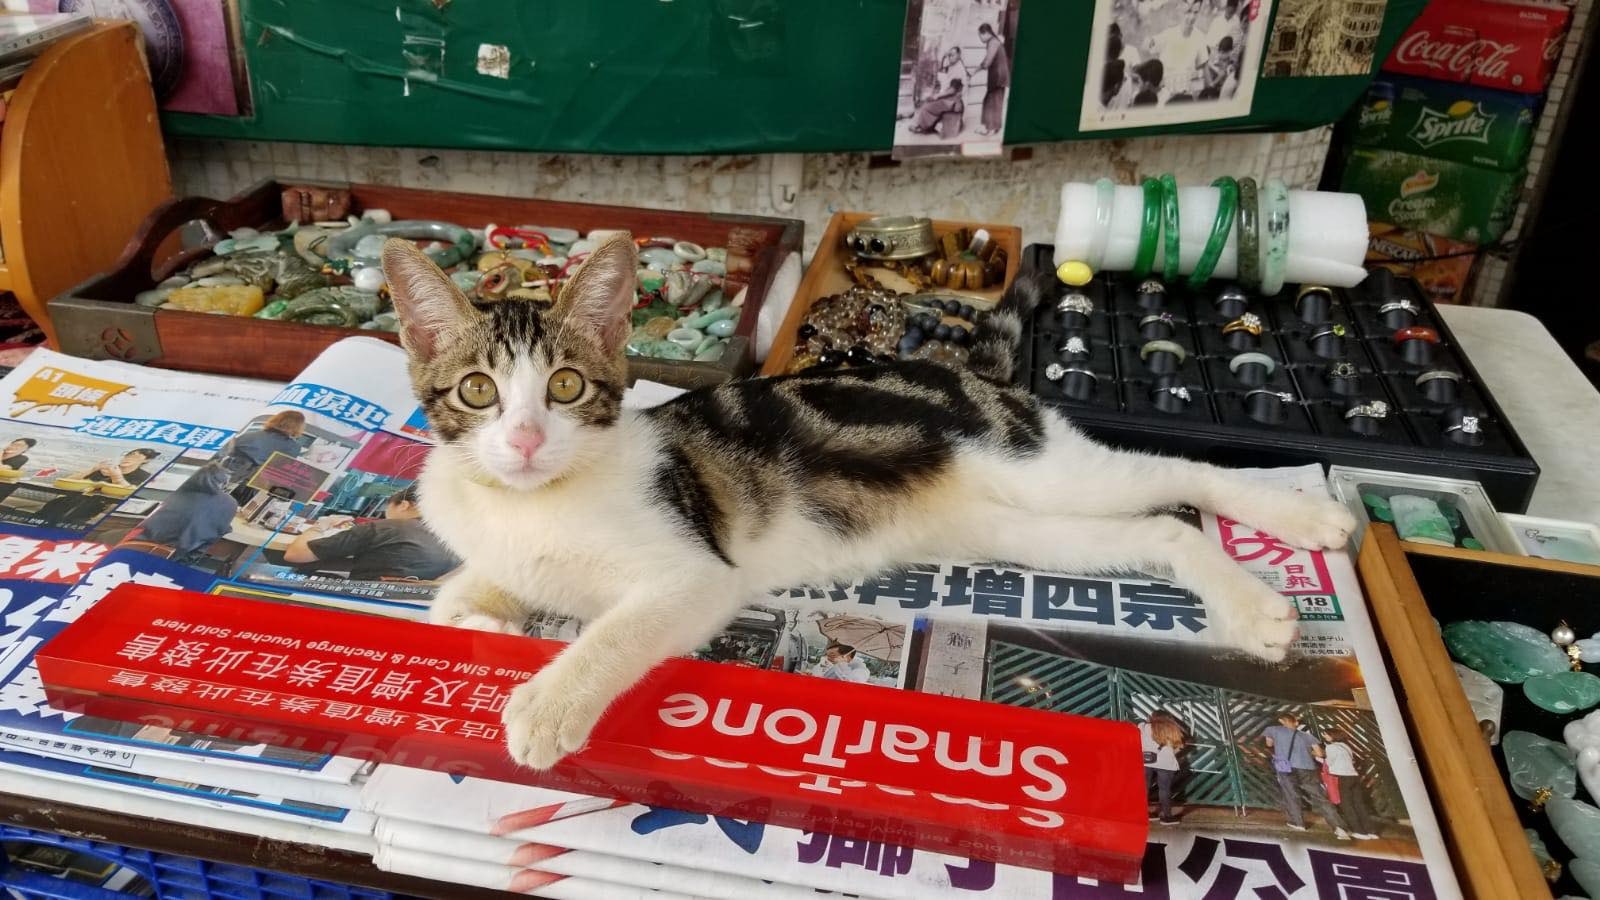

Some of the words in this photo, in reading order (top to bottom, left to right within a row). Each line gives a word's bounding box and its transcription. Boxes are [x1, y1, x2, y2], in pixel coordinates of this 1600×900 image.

[1416, 112, 1487, 142] Sprite
[1302, 597, 1328, 607] 18
[152, 618, 192, 633] Here
[191, 623, 232, 639] Sold
[234, 630, 302, 650] Voucher
[306, 640, 388, 662] Recharge
[390, 653, 406, 665] &
[407, 655, 450, 671] Card
[452, 662, 491, 676] SIM
[658, 692, 1069, 802] SmarTone
